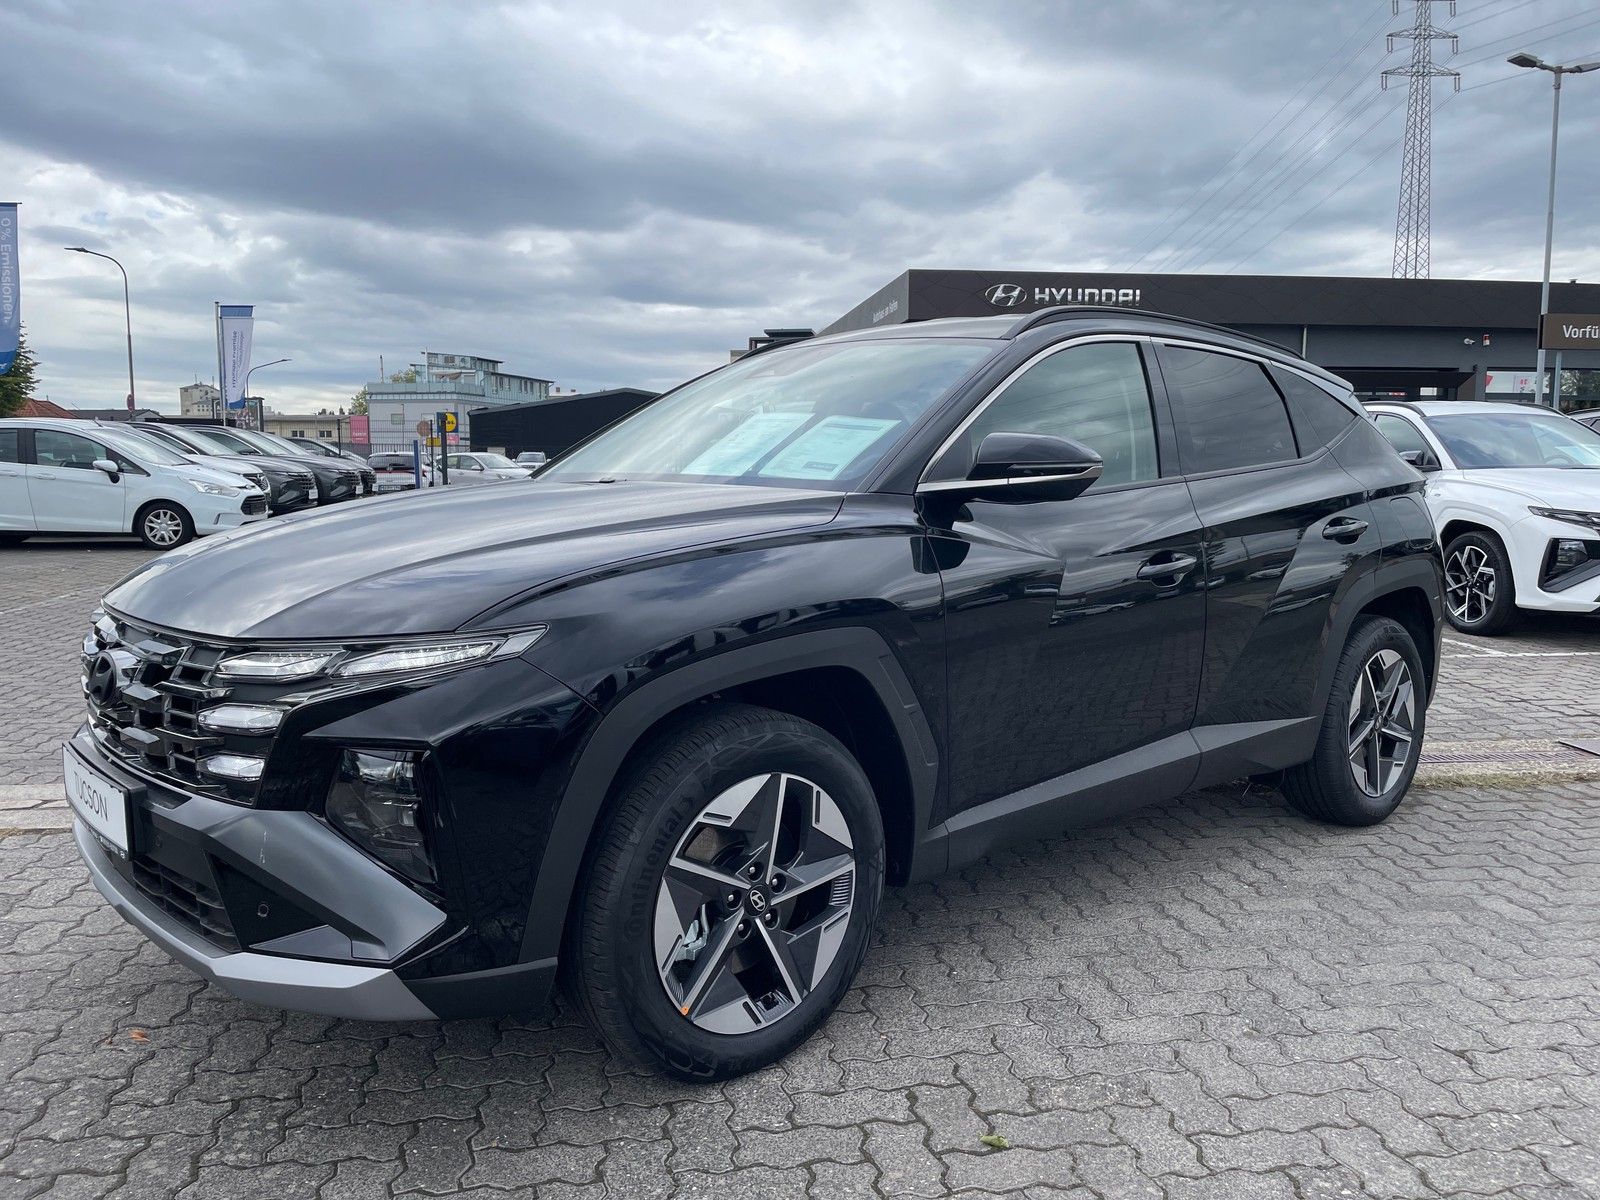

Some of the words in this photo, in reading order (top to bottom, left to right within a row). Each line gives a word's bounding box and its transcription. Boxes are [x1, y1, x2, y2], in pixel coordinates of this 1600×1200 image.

[1, 244, 14, 323] Emissionen.
[1034, 287, 1142, 303] HYUNDAI
[1562, 324, 1599, 339] Vorfü
[73, 770, 108, 821] TUCSON
